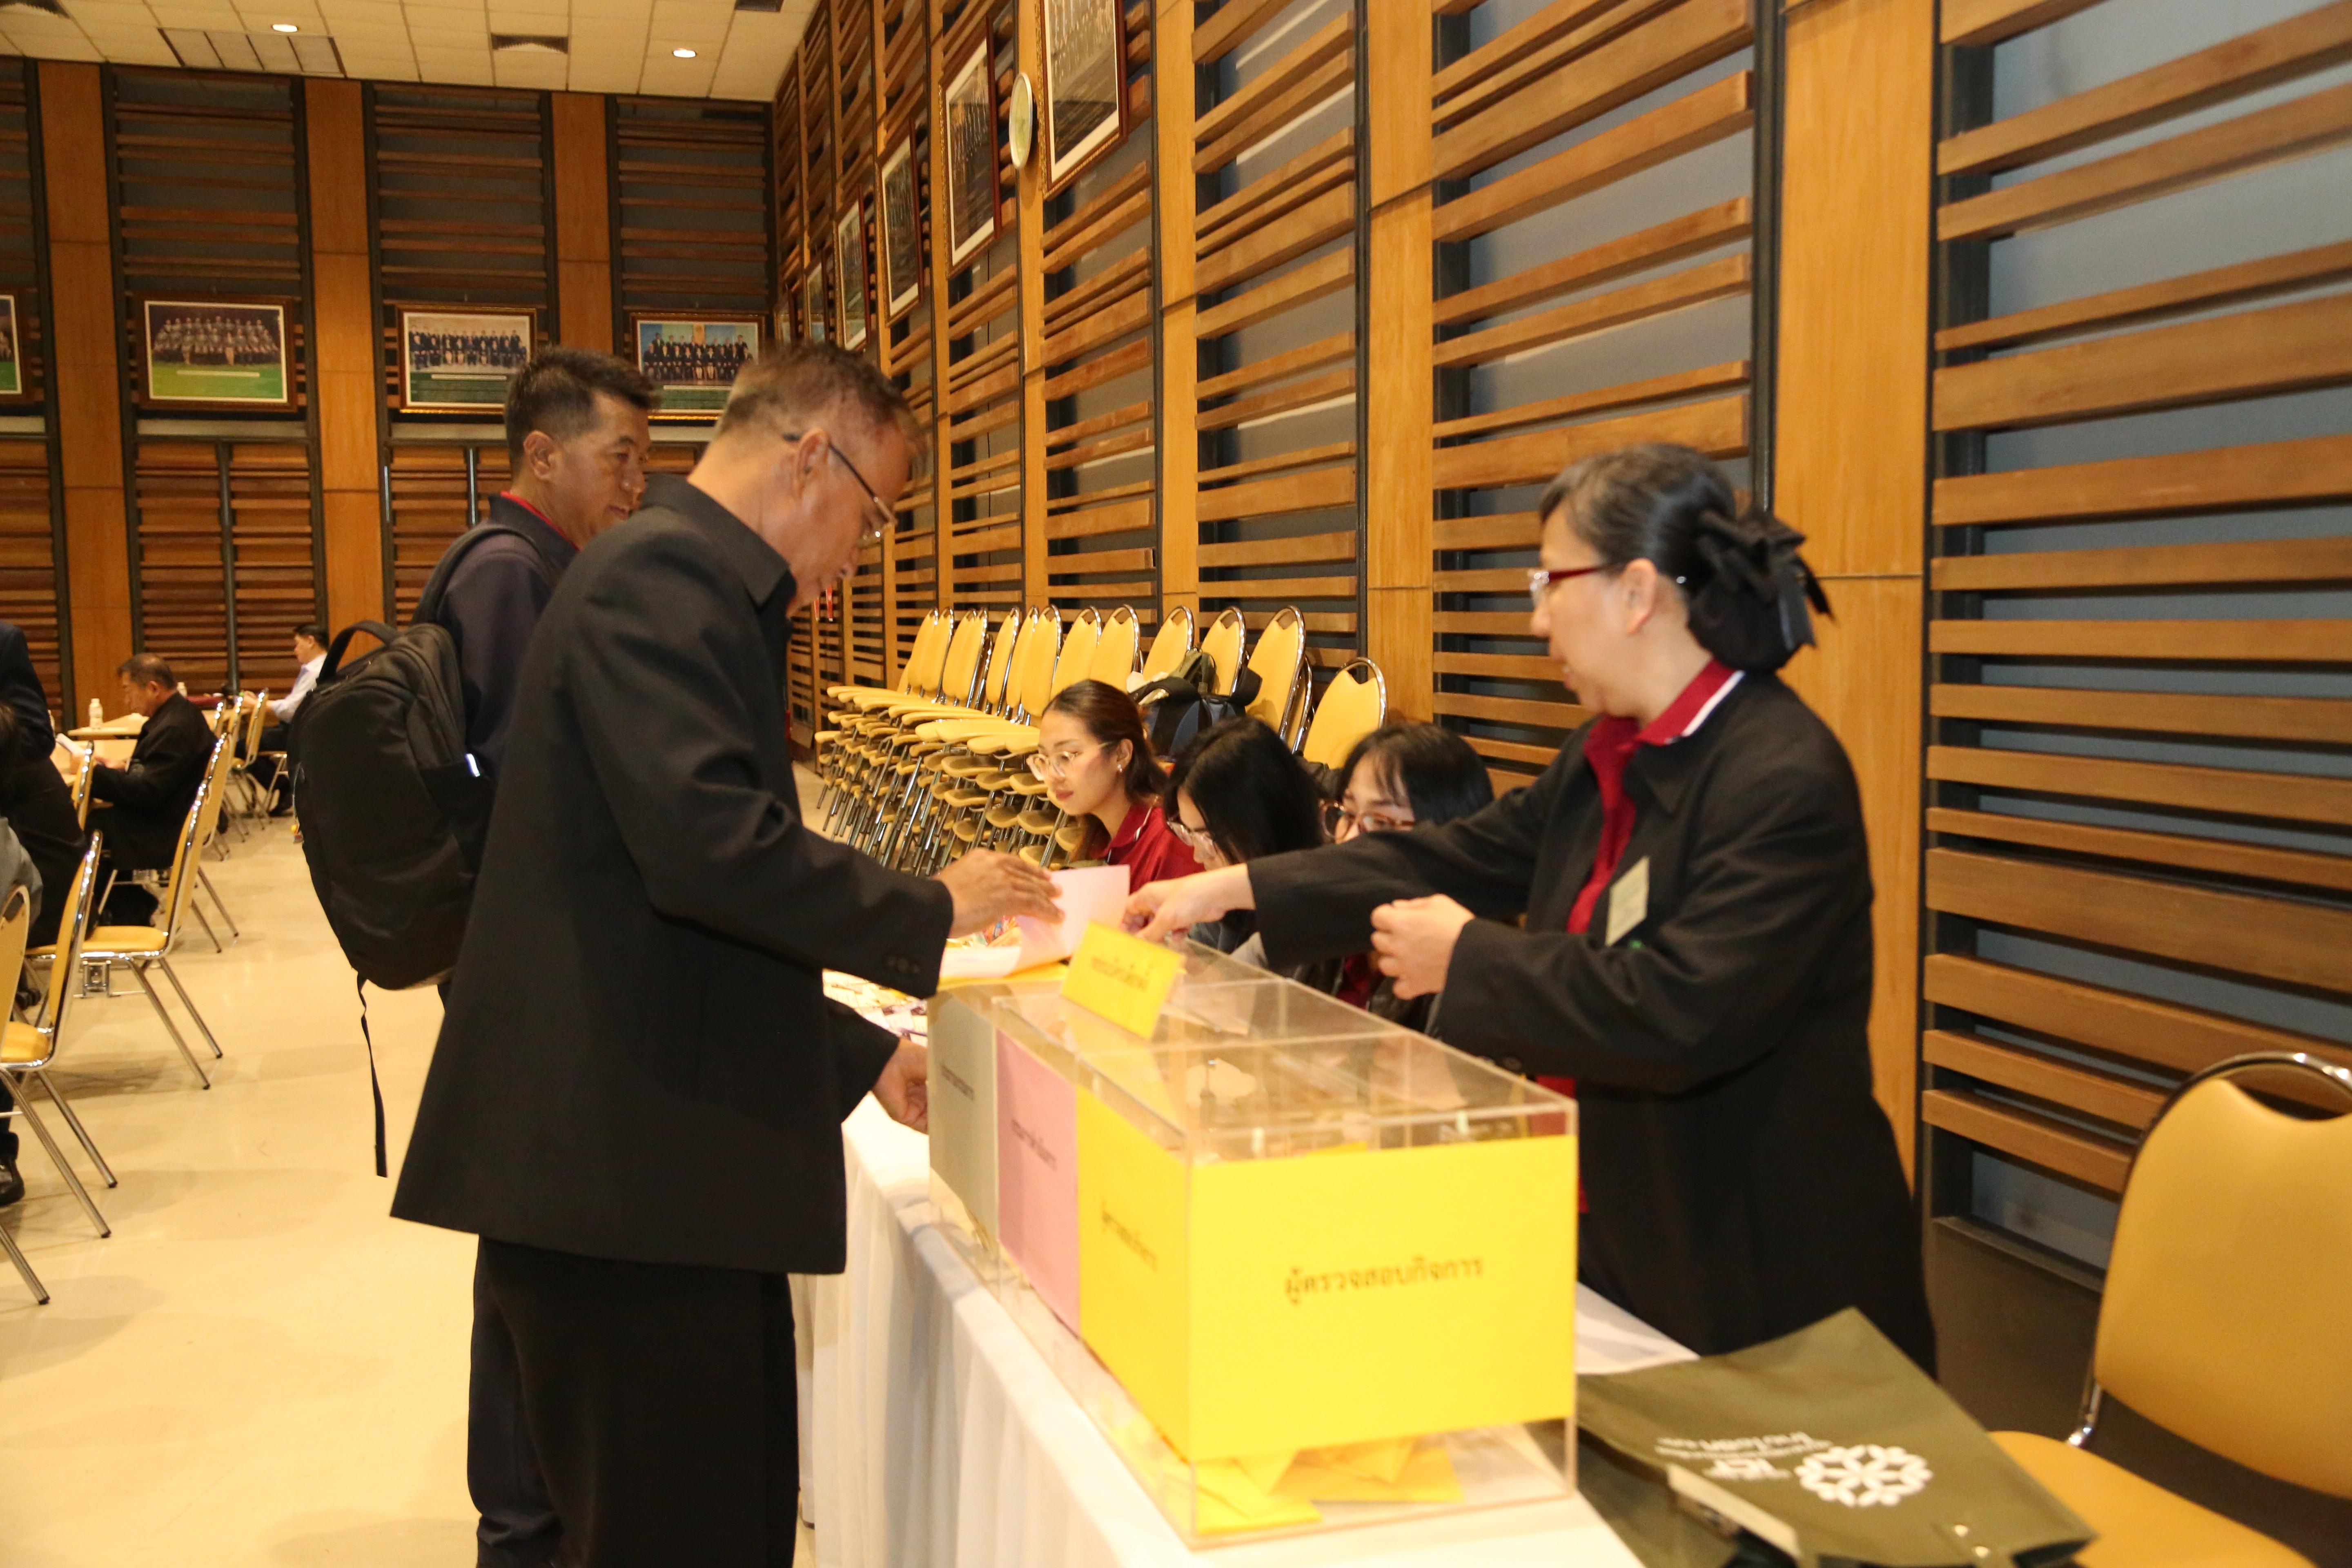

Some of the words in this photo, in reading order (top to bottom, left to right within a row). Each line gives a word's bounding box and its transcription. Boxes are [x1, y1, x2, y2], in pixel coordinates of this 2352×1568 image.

[1285, 1254, 1483, 1305] ผู้ตรวจสอบกิจการ
